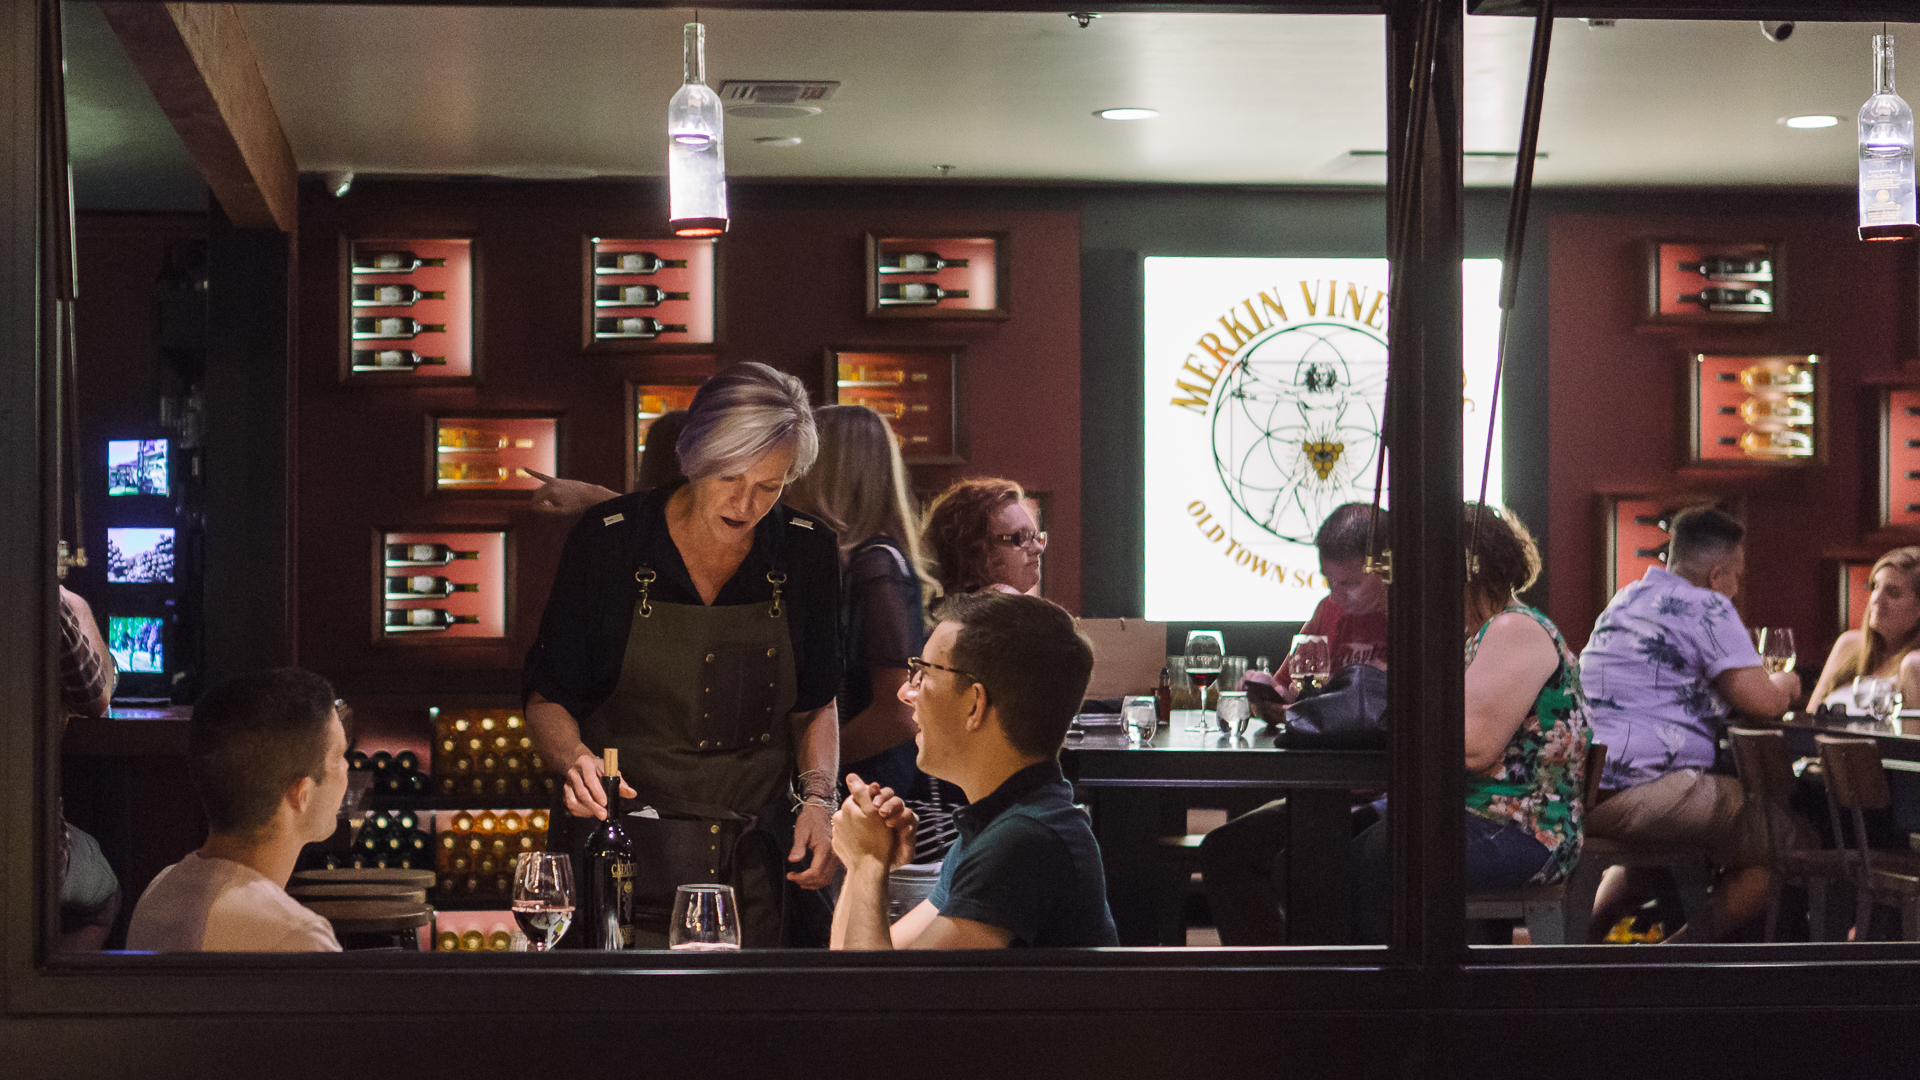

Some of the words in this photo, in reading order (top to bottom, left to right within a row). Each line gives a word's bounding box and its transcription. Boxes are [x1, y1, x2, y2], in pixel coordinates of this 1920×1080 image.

[1170, 286, 1288, 415] MERKIN
[1299, 279, 1388, 336] VINE
[1187, 500, 1225, 543] OLD
[1225, 538, 1288, 585] TOWN
[1292, 569, 1330, 591] SC
